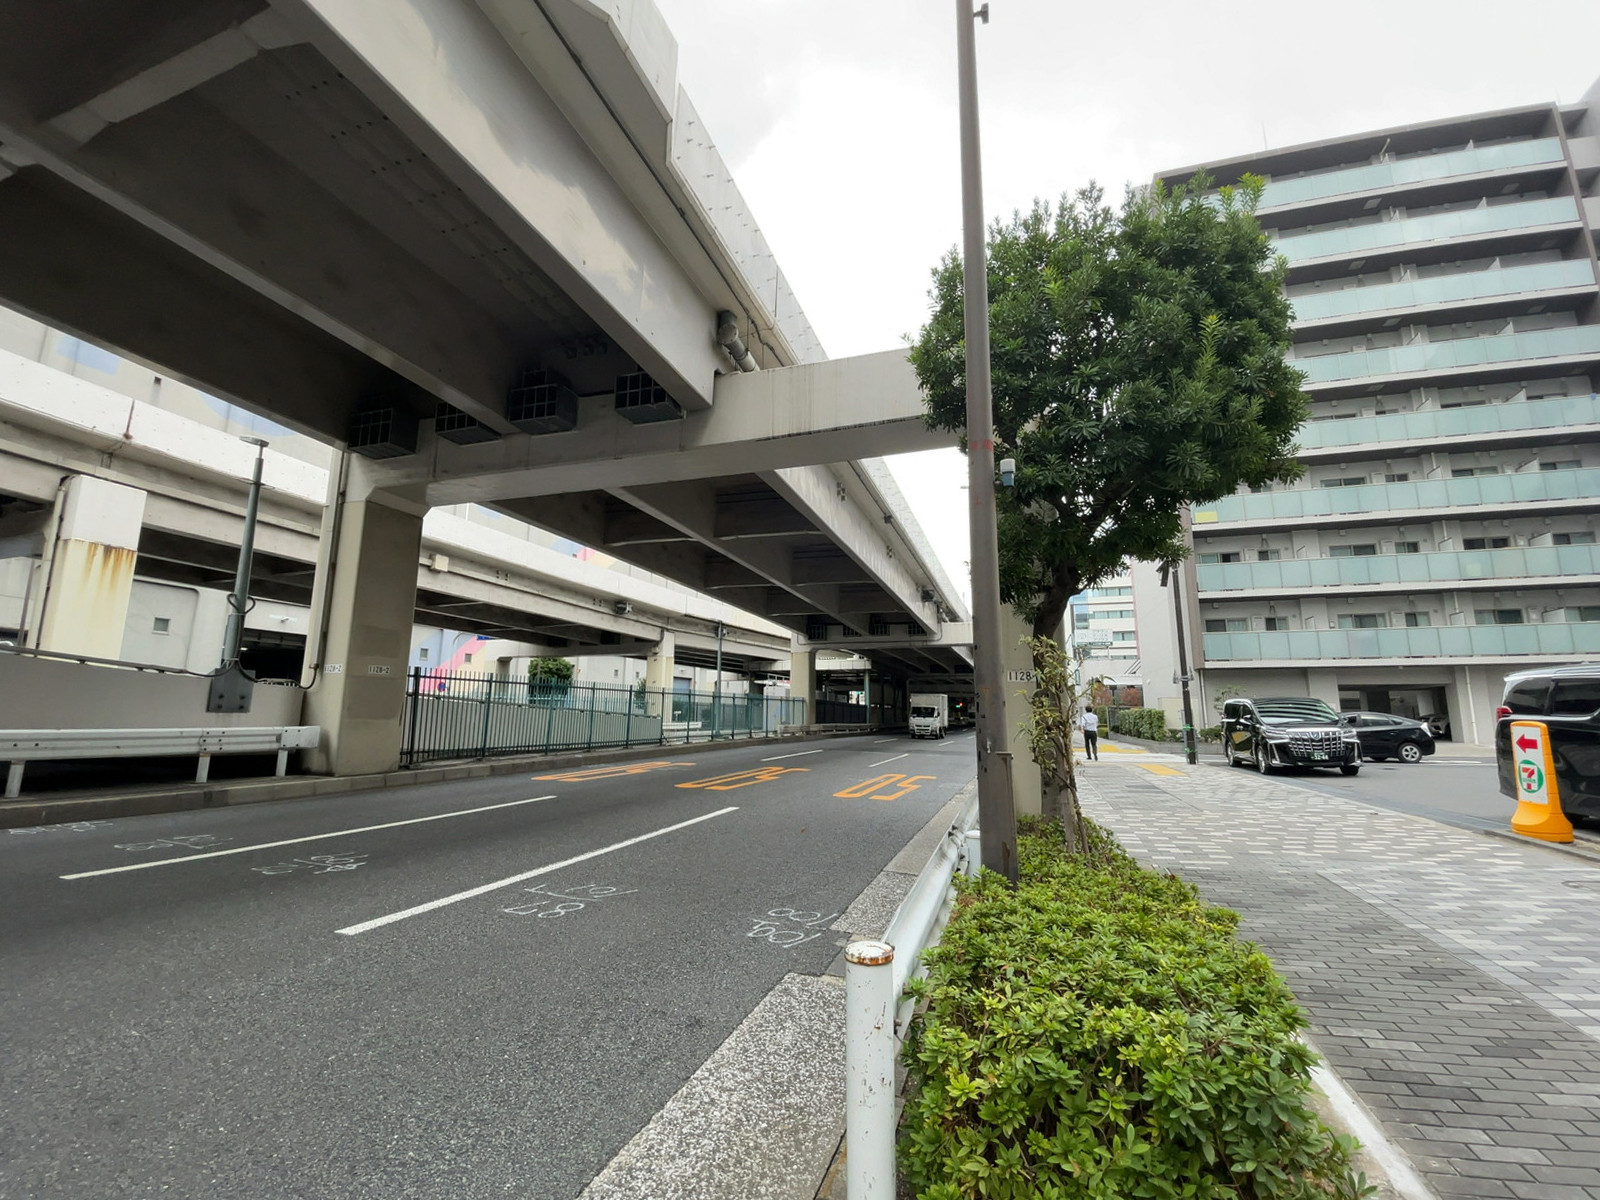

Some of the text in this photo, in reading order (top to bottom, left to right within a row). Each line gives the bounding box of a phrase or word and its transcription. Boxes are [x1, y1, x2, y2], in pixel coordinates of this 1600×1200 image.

[369, 665, 391, 674] 1128-2
[674, 765, 812, 791] 50
[832, 773, 937, 801] 50
